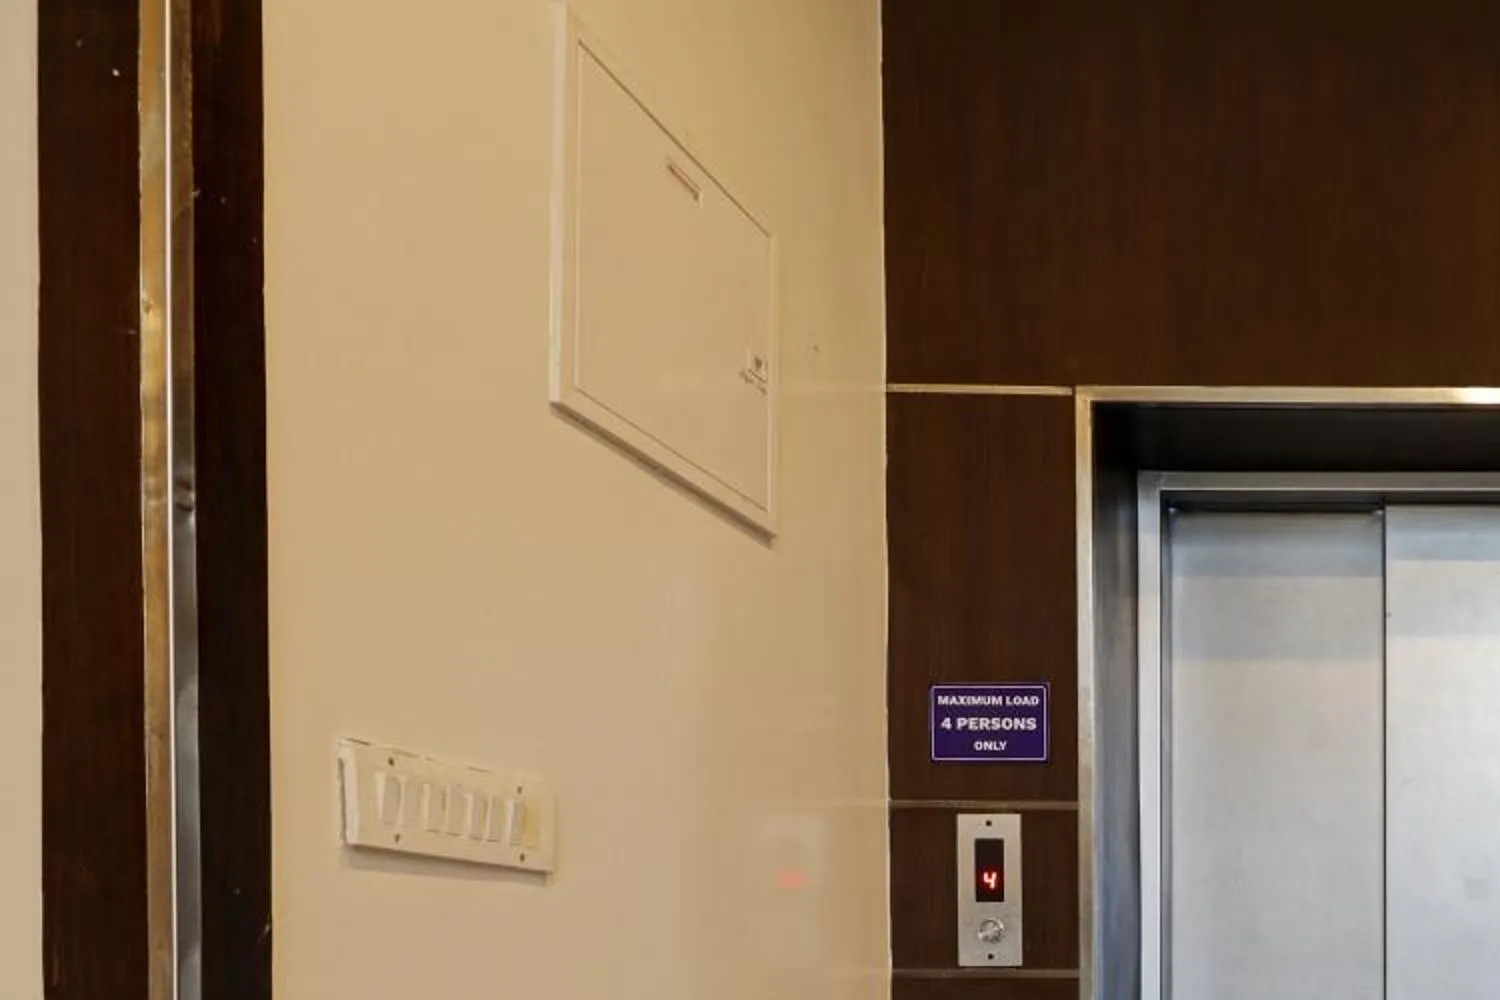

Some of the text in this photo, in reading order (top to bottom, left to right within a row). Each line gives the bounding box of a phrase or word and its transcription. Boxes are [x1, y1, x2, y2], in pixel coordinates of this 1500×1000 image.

[937, 695, 1039, 706] MAXIMUM LOAD
[941, 717, 1037, 731] 4 PERSONS
[974, 740, 1008, 751] ONLY
[983, 871, 997, 889] 4
